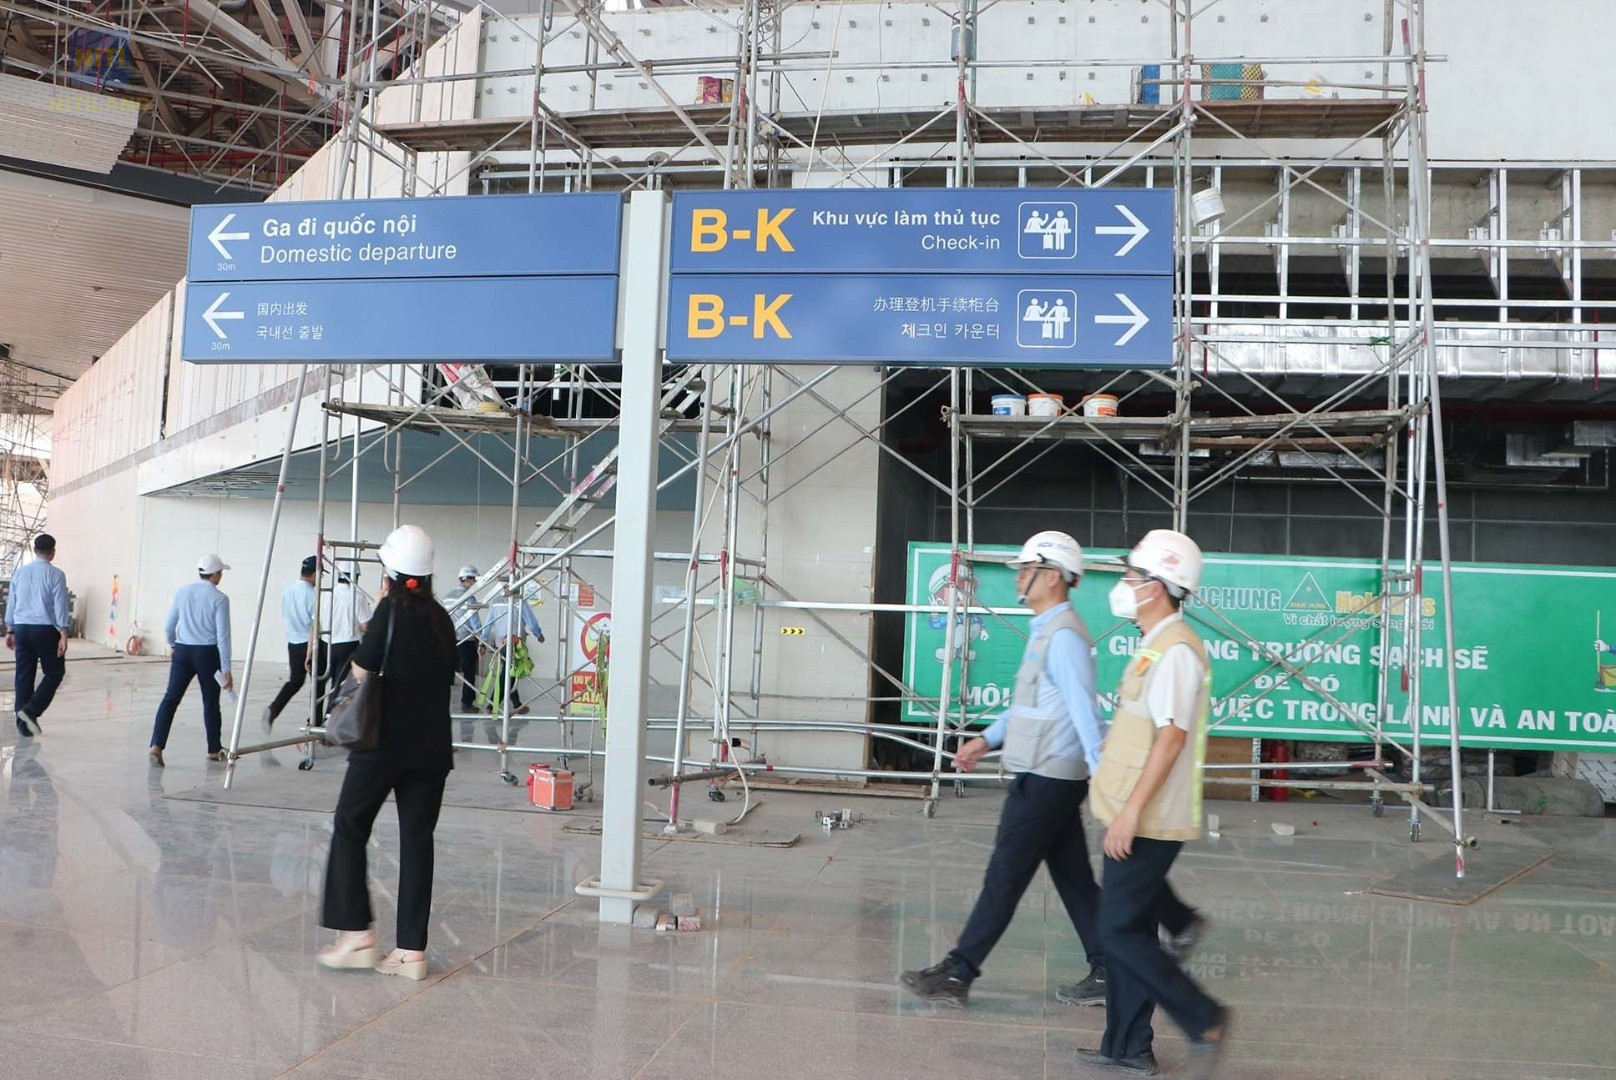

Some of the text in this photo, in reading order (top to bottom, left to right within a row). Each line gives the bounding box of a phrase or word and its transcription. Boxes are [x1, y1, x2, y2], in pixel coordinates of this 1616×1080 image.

[263, 213, 417, 239] Ga đi quốc nội
[812, 208, 1001, 228] Khu vực làm thủ tục
[690, 208, 797, 252] B-K
[921, 234, 1000, 250] Check-in
[260, 242, 457, 265] Domestic departure
[216, 262, 236, 272] 30m
[257, 301, 308, 316] 国内出发
[873, 296, 1000, 313] 办理登机手续柜台
[687, 293, 794, 339] B-K
[256, 324, 324, 340] 국내선 출발
[901, 322, 1000, 340] 체크인 카운터
[210, 341, 231, 351] 30m
[1454, 645, 1489, 670] SẼ
[1210, 693, 1274, 722] VIỆC
[1283, 699, 1376, 724] TRONG
[1470, 703, 1507, 728] VÀ
[1516, 709, 1555, 731] AN
